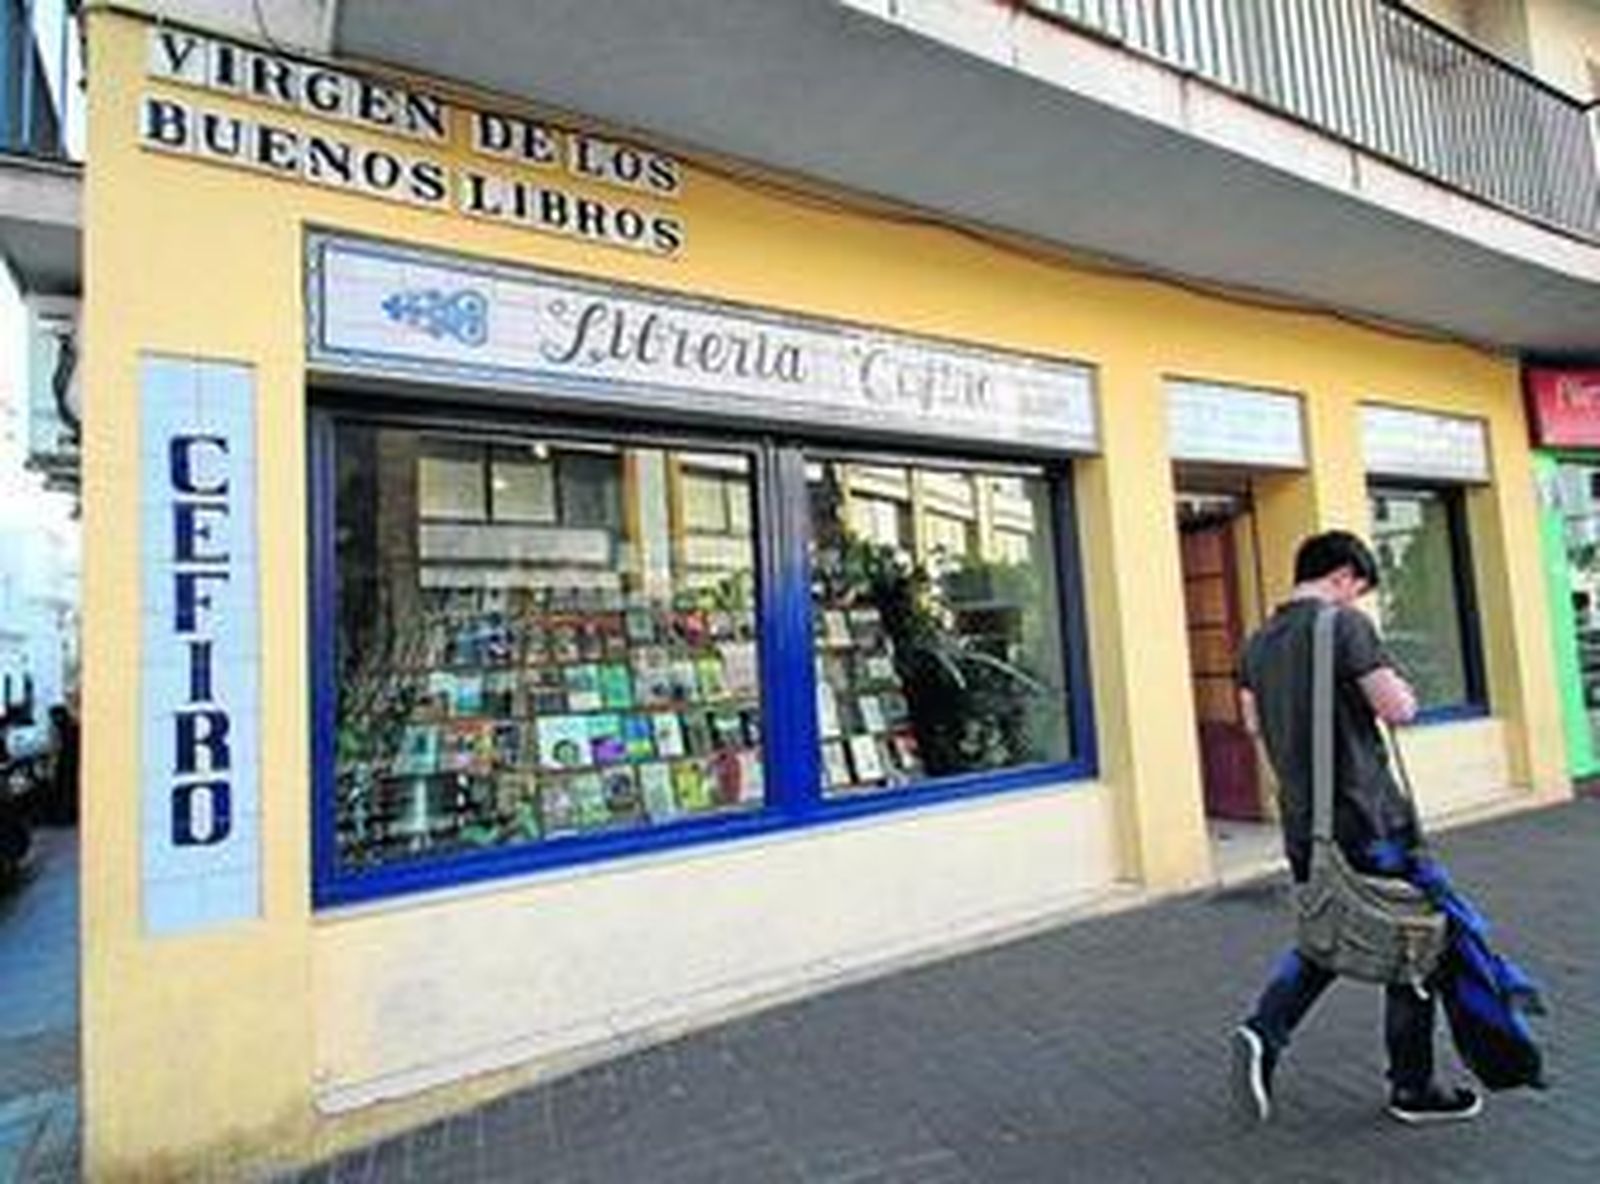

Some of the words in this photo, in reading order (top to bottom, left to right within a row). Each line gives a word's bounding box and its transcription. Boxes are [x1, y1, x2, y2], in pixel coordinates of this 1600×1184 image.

[146, 98, 446, 202] BUENOS
[468, 175, 681, 253] LIBROS
[158, 33, 447, 137] VIRGEN
[478, 115, 556, 163] DE
[576, 139, 679, 192] LOS
[169, 434, 233, 847] CEFIRO
